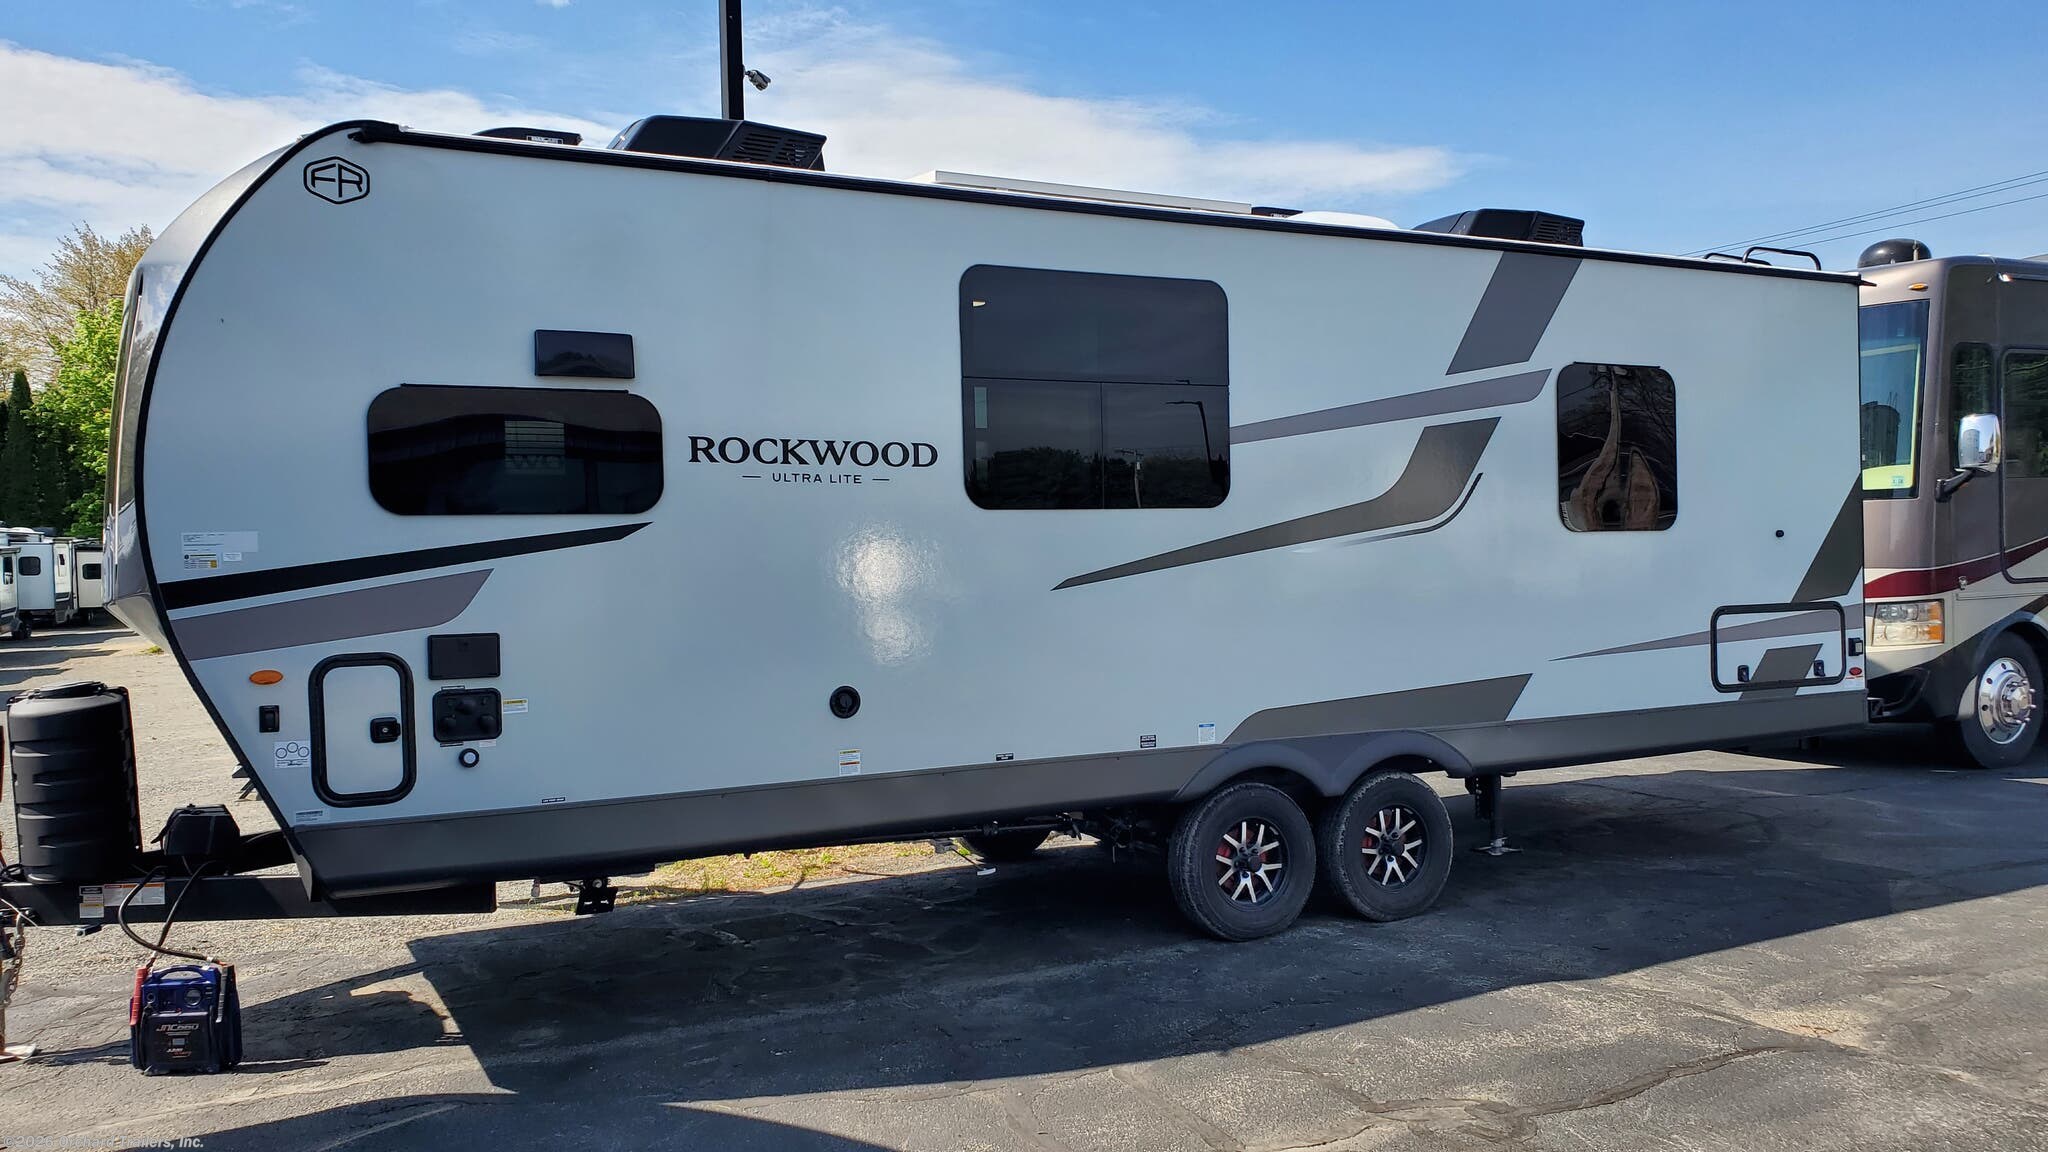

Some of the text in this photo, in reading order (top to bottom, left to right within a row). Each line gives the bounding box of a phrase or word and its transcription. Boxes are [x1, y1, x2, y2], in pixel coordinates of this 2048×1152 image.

[310, 163, 363, 198] FR
[687, 435, 938, 468] ROCKWOOD
[772, 472, 863, 484] ULTRA LITE
